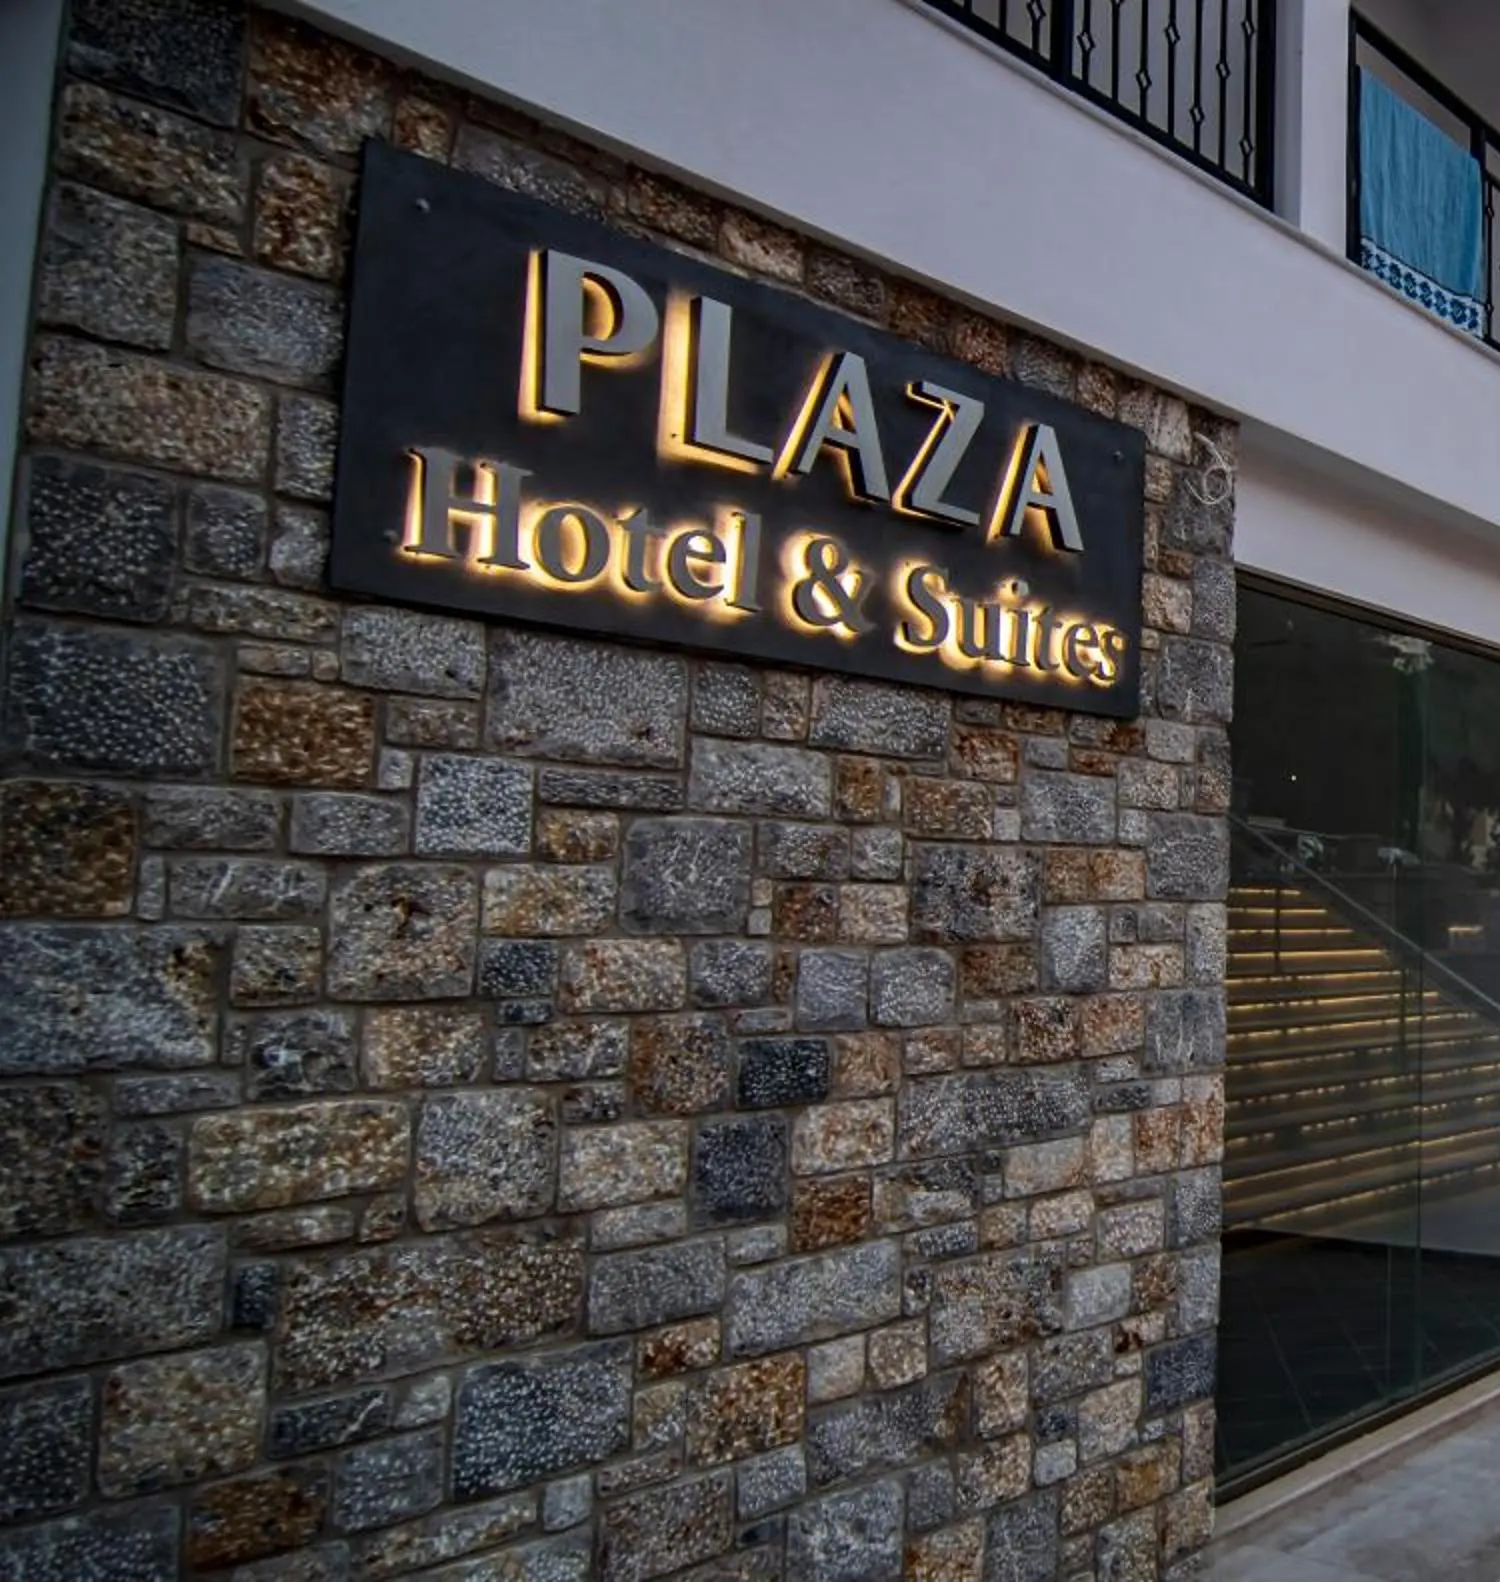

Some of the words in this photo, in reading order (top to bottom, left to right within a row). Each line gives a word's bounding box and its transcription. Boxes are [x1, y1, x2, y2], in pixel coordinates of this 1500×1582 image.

[528, 248, 1084, 552] PLAZA
[404, 447, 762, 613] Hotel
[791, 533, 875, 634] &
[899, 562, 1125, 684] Suites
